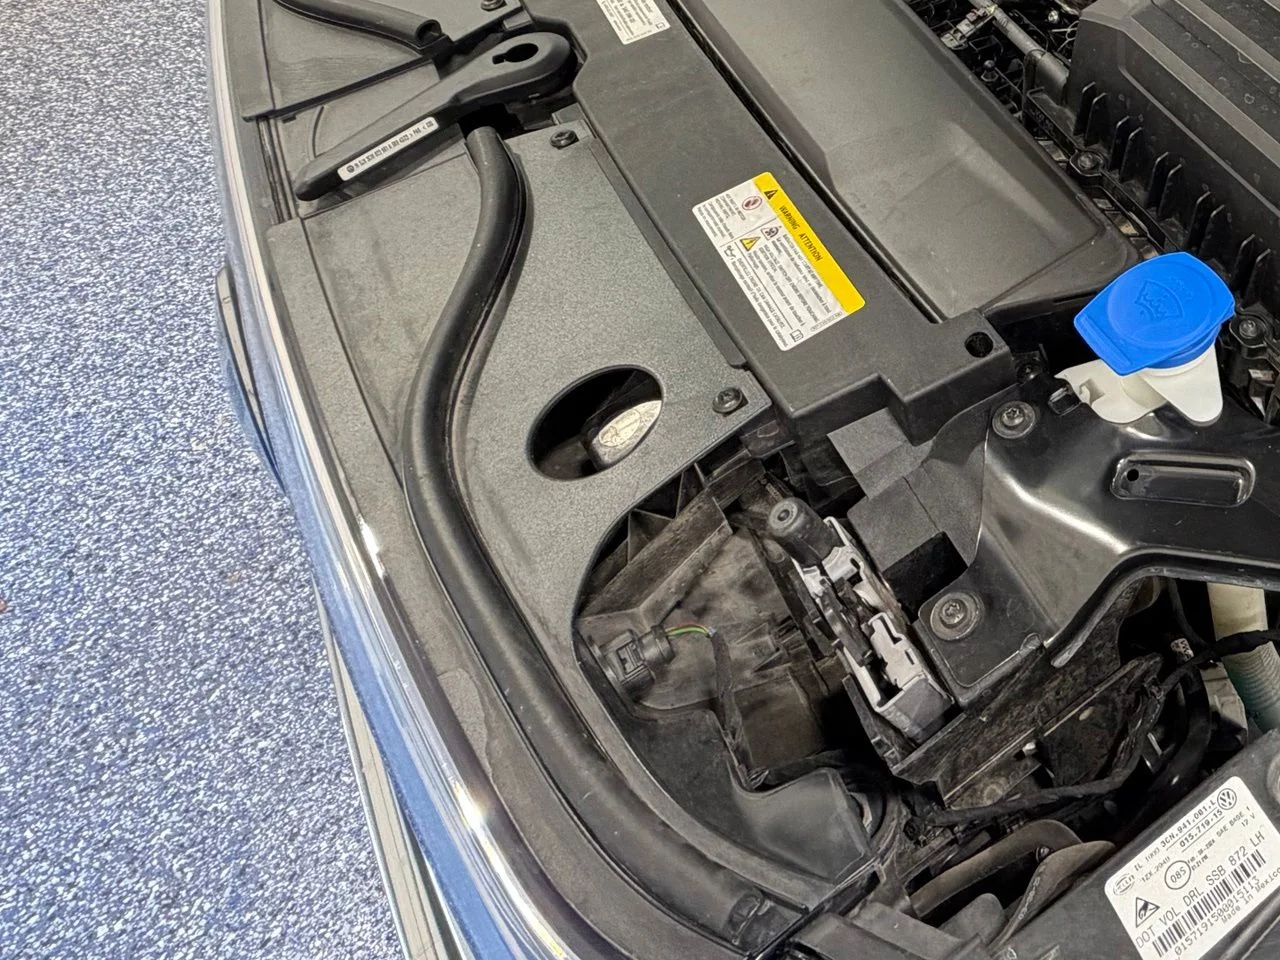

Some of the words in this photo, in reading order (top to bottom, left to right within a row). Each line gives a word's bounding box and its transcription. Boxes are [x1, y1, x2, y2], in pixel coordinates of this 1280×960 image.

[779, 205, 799, 231] WARNING
[799, 233, 822, 262] ATTENTION
[1135, 925, 1155, 948] DOT
[1158, 907, 1181, 926] VOL
[1182, 887, 1204, 907] DRL
[1206, 865, 1226, 886] SSB
[1228, 845, 1248, 866] 872
[1249, 831, 1265, 847] LH
[1219, 904, 1241, 924] Made
[1240, 891, 1254, 905] in
